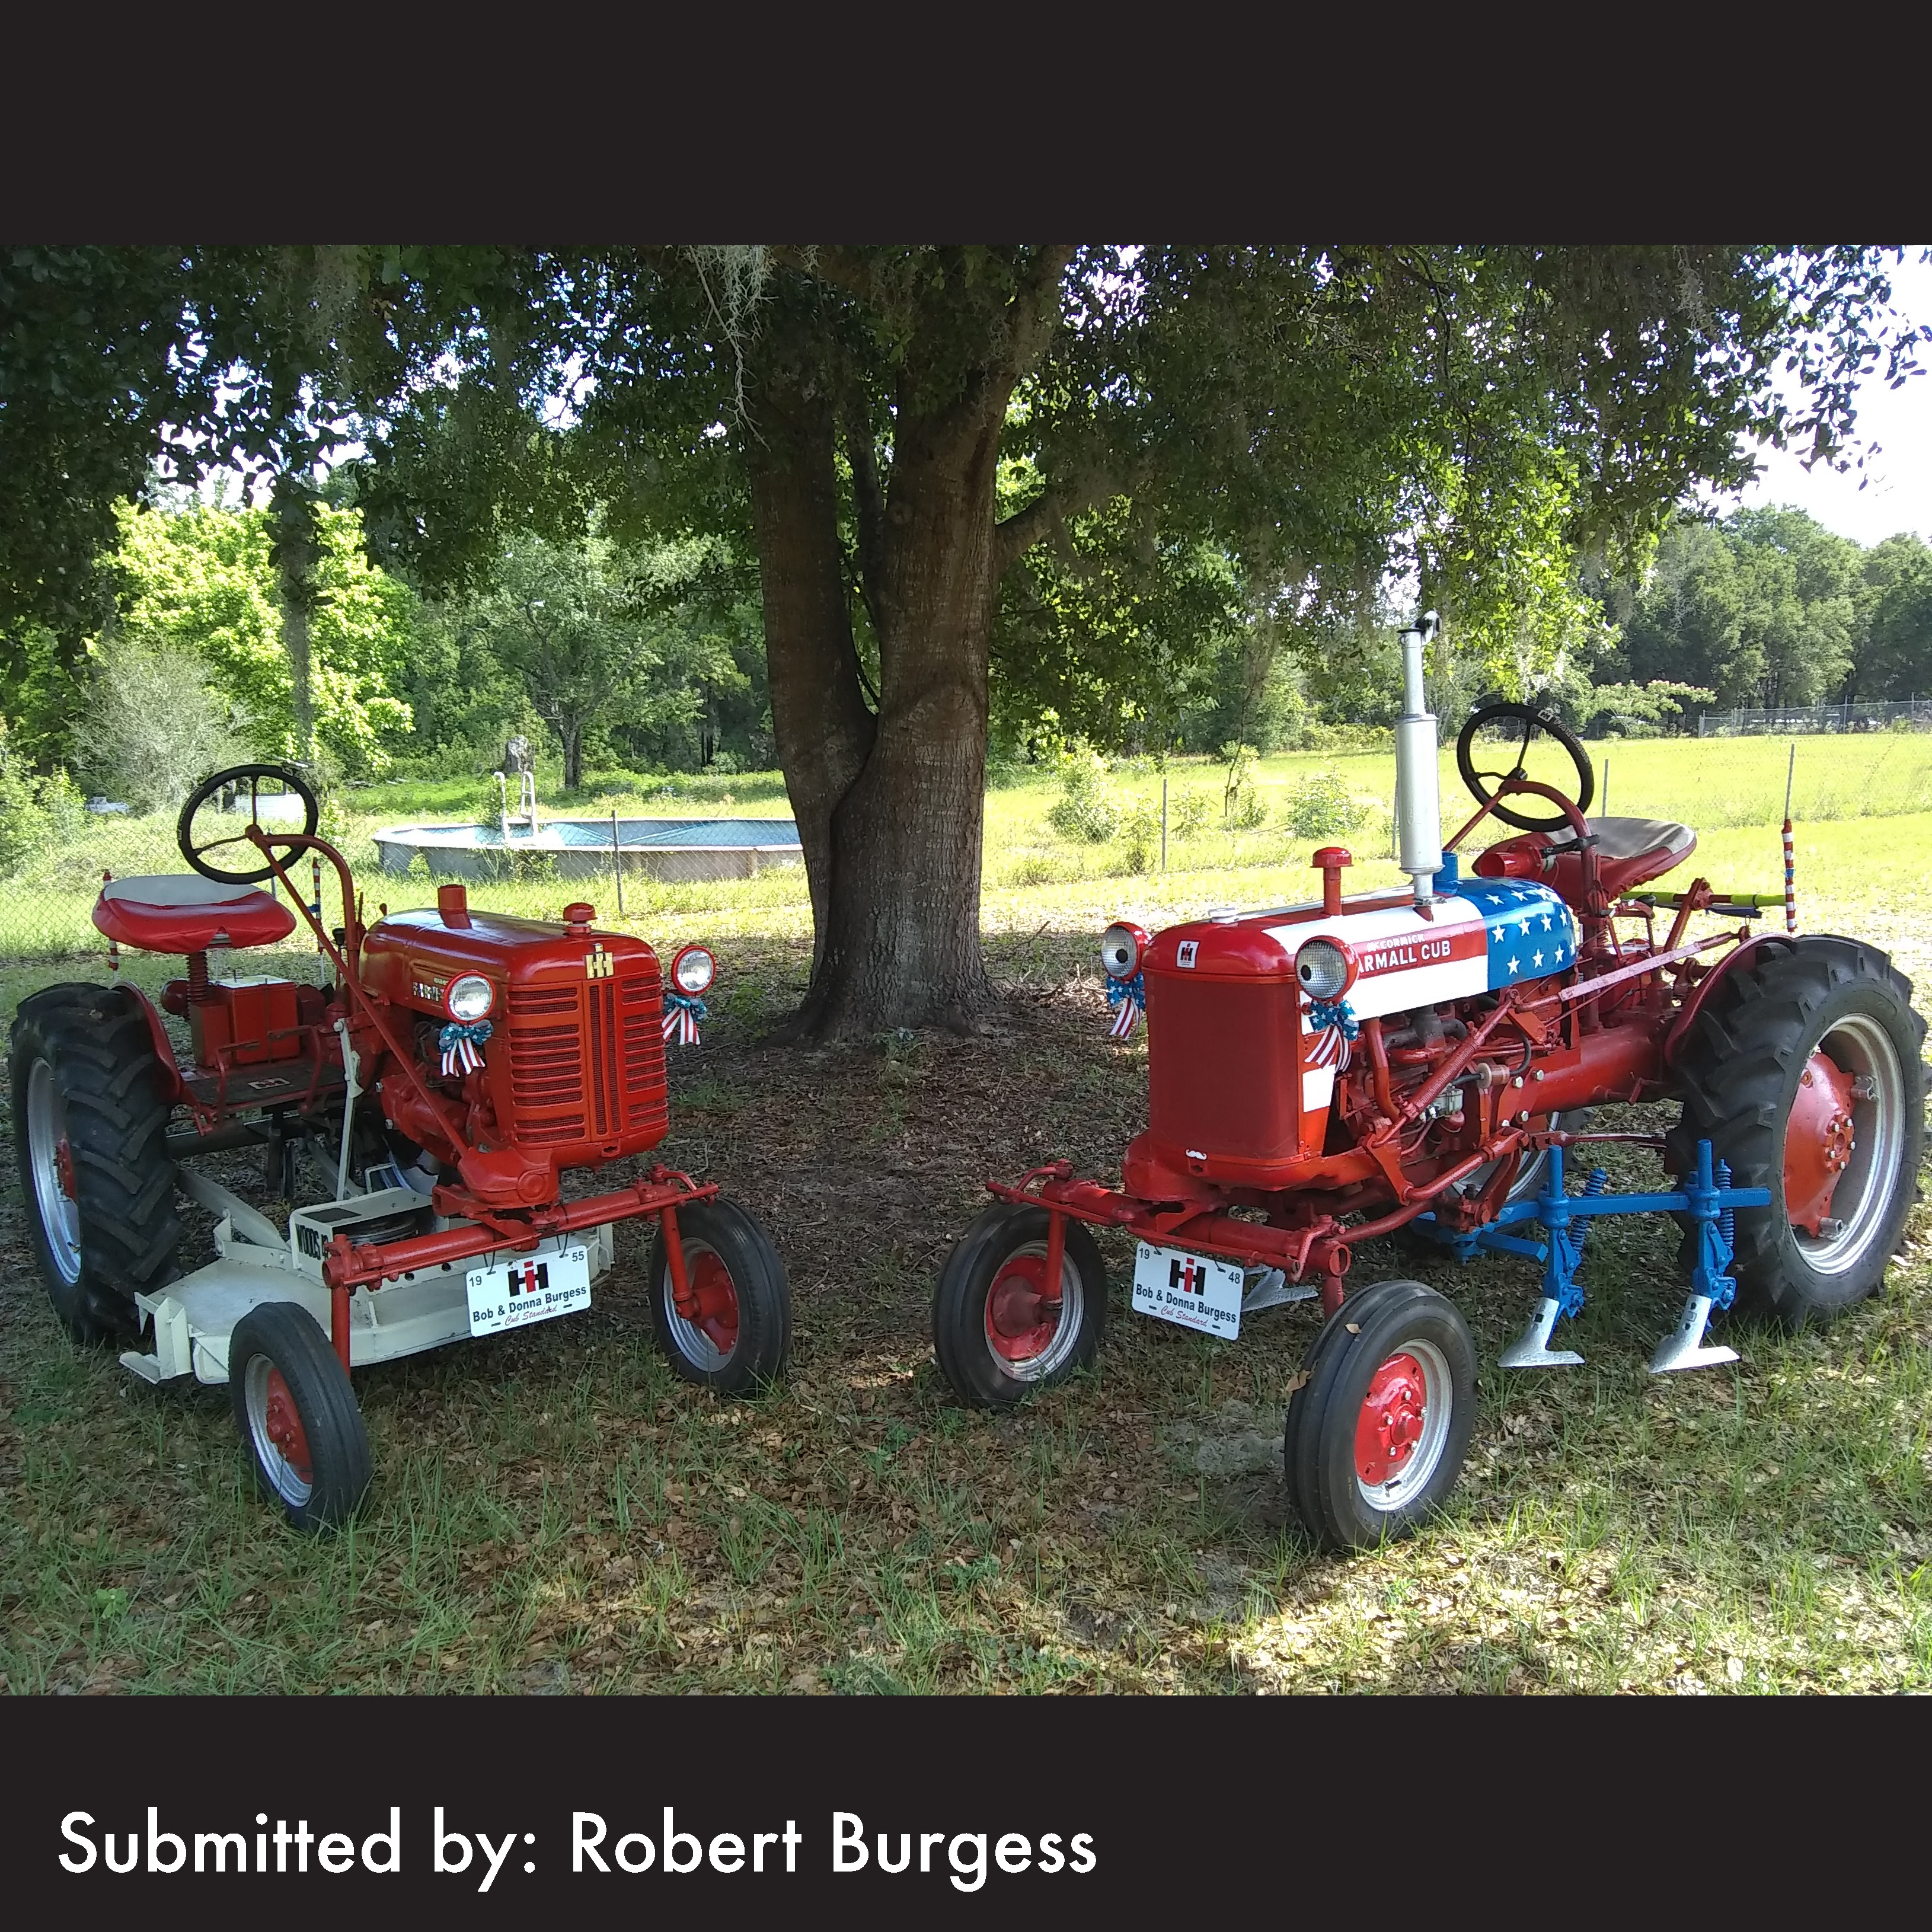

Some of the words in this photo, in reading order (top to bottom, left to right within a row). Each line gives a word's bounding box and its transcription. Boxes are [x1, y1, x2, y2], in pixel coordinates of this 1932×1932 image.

[1358, 947, 1417, 973] ARMALL
[1421, 940, 1451, 960] CUB
[571, 1250, 585, 1262] 55
[1139, 1247, 1150, 1260] 19
[469, 1275, 483, 1287] 19
[1228, 1272, 1241, 1284] 48
[472, 1308, 494, 1323] Bob
[497, 1305, 505, 1316] &
[509, 1297, 542, 1313] Donna
[545, 1286, 586, 1304] Burgess
[1136, 1283, 1153, 1298] Bob
[1156, 1289, 1163, 1301] &
[1166, 1292, 1195, 1311] Donna
[1197, 1301, 1237, 1323] Burgess
[504, 1313, 520, 1326] Cub
[522, 1304, 558, 1321] Standard
[1160, 1305, 1174, 1316] Cub
[1176, 1310, 1209, 1327] Standard
